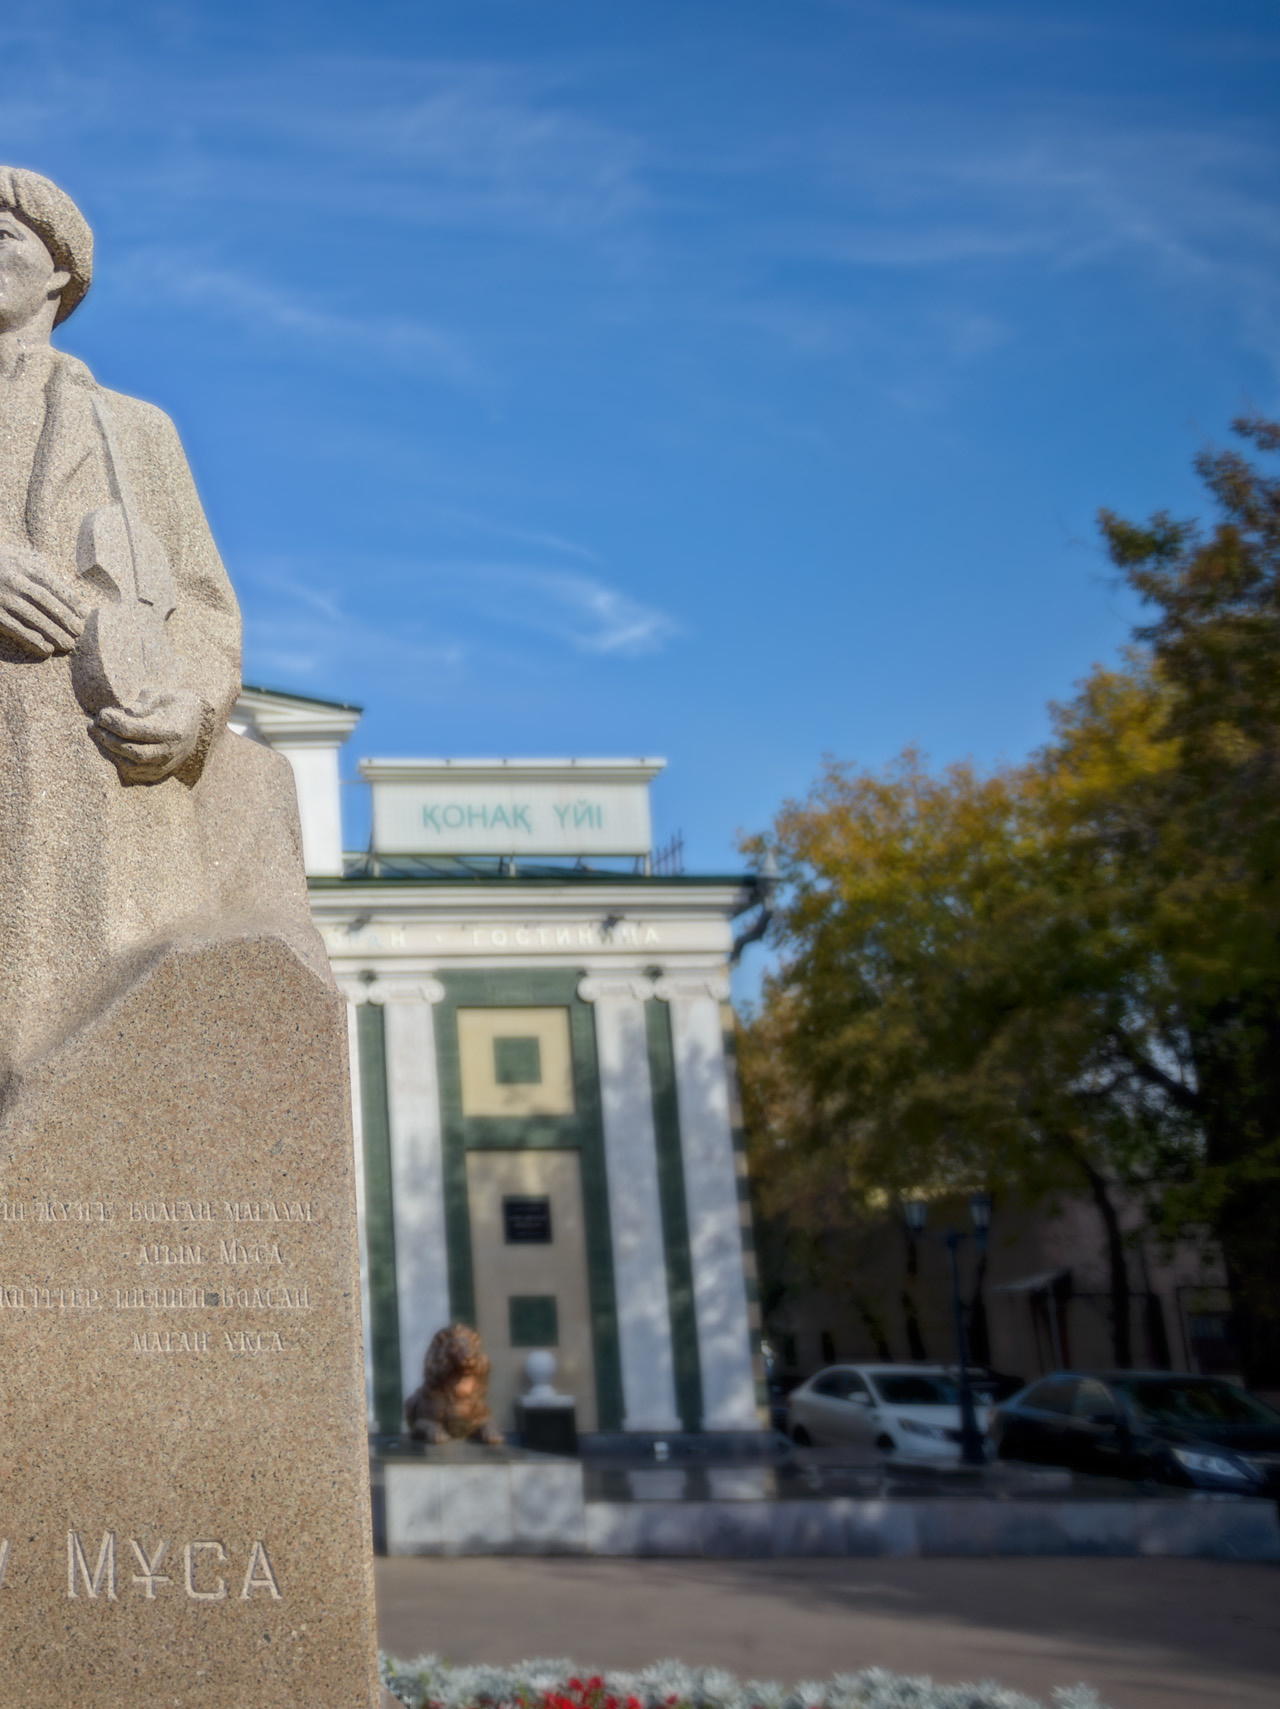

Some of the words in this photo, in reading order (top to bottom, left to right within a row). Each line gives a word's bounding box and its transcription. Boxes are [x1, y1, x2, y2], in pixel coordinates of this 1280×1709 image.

[422, 804, 531, 834] ҚОНАҚ
[553, 799, 603, 829] ҮЙІ
[473, 927, 660, 949] ГОСТИНИЦА
[66, 1528, 284, 1601] МҰСА
